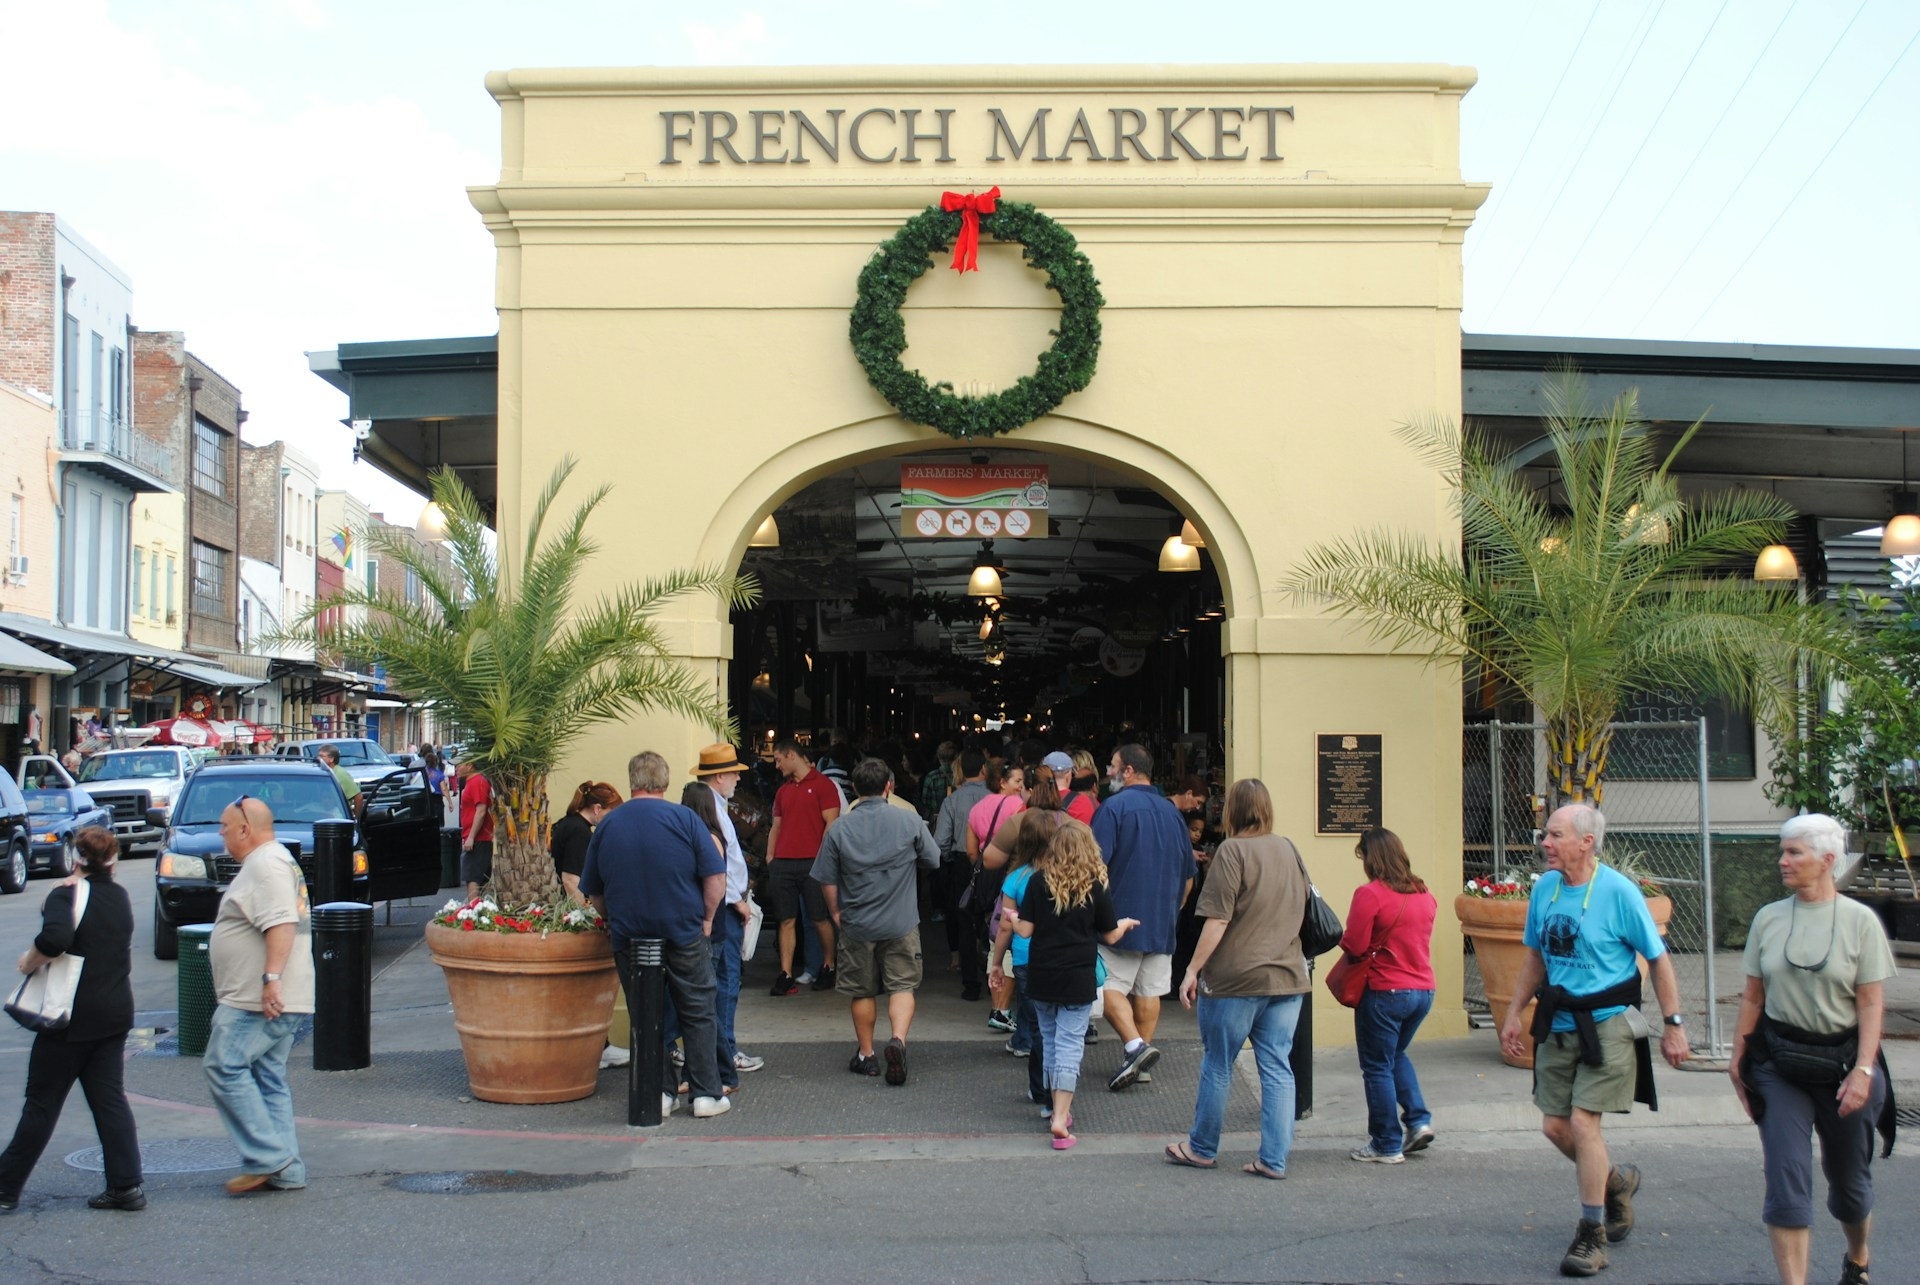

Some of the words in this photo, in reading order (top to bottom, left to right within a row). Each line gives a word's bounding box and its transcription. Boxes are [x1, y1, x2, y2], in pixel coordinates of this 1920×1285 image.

[658, 107, 957, 165] FRENCH
[985, 105, 1295, 162] MARKET
[908, 467, 977, 479] FARMERS'
[981, 468, 1040, 479] MARKET
